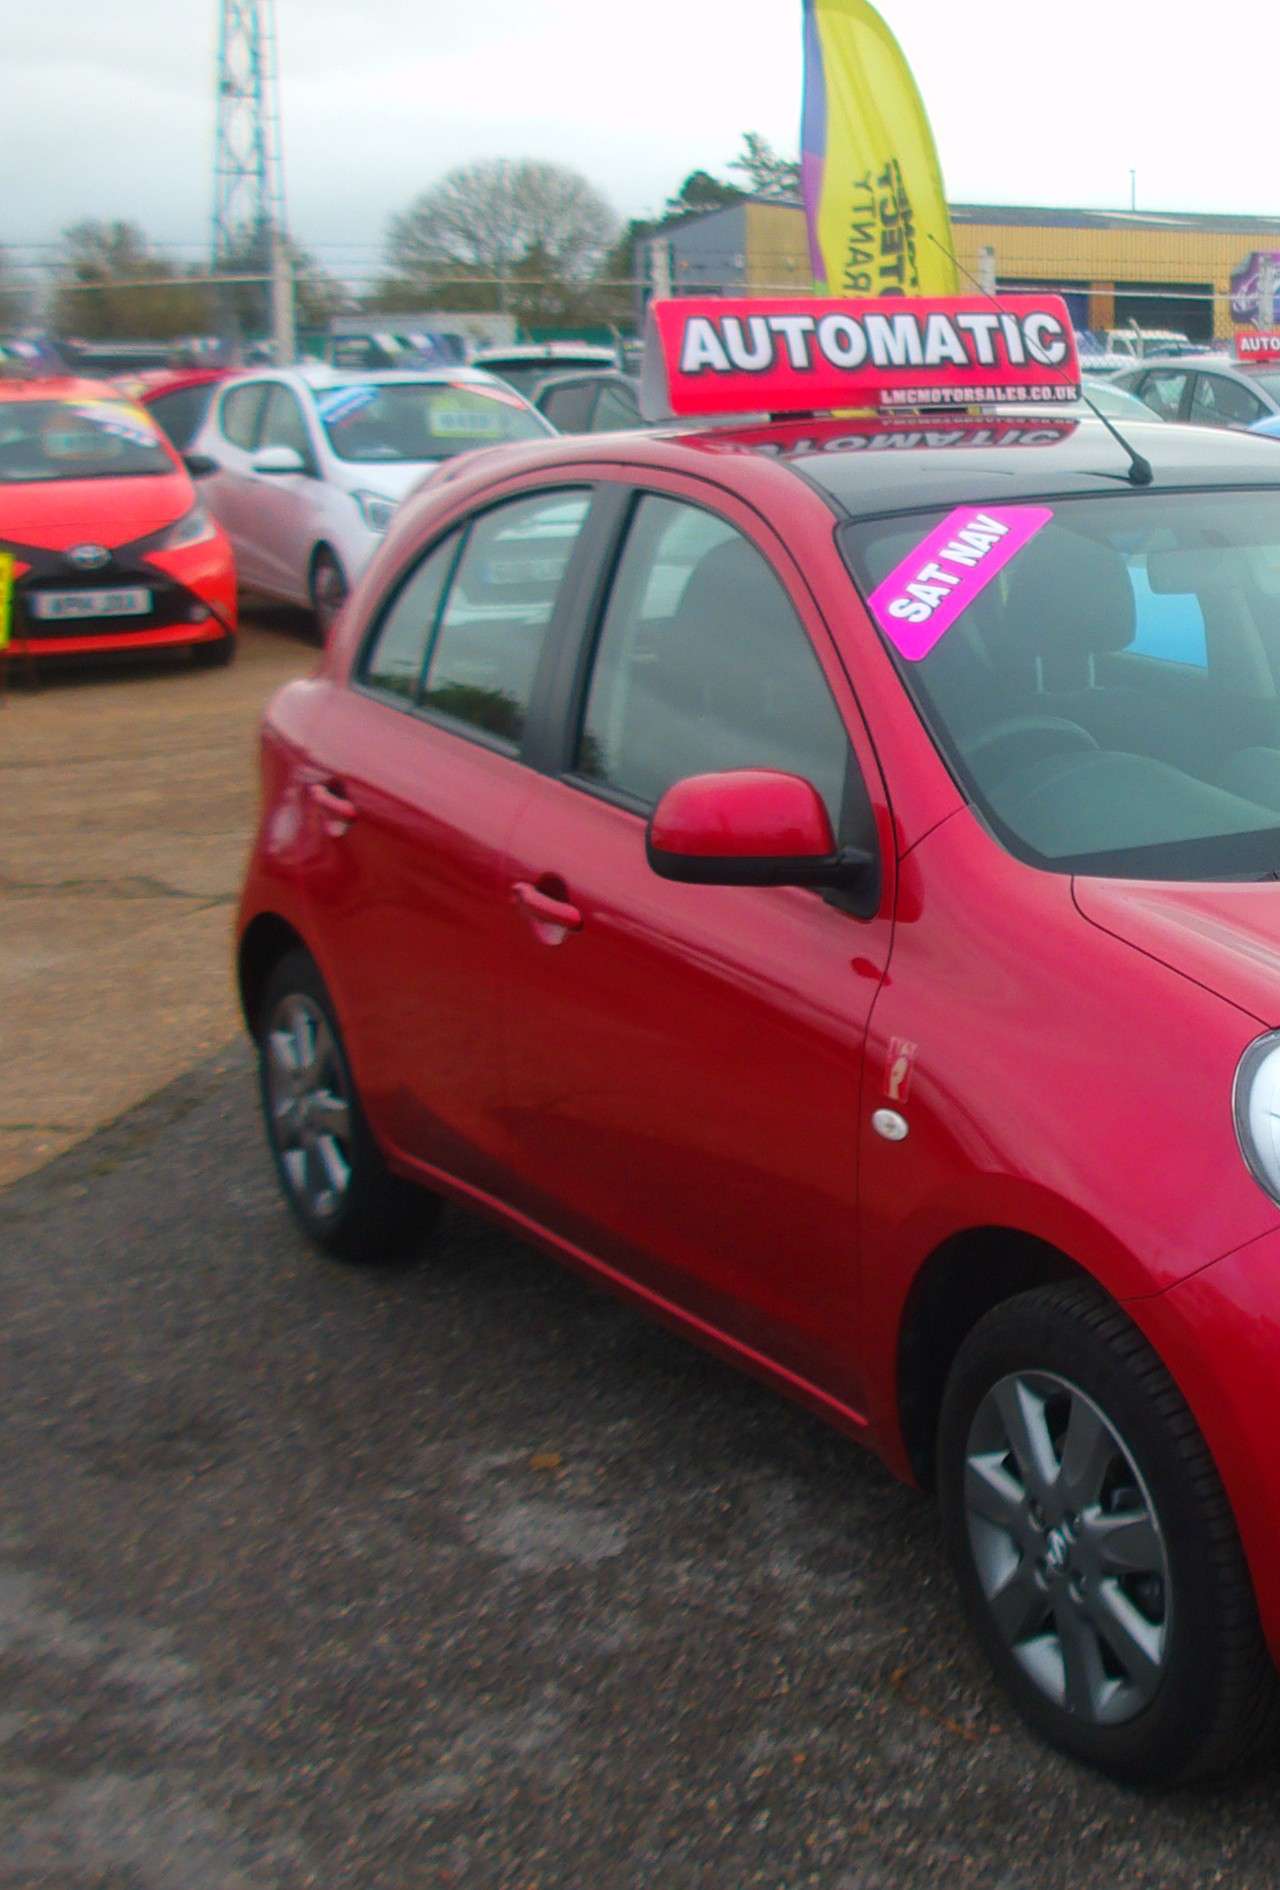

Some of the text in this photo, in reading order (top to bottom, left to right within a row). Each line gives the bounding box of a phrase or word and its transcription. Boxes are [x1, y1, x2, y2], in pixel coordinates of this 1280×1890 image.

[680, 312, 1068, 373] AUTOMATIC
[881, 385, 1078, 405] LMCMOTORSALES.CO.UK
[888, 513, 1010, 623] SAT NAV
